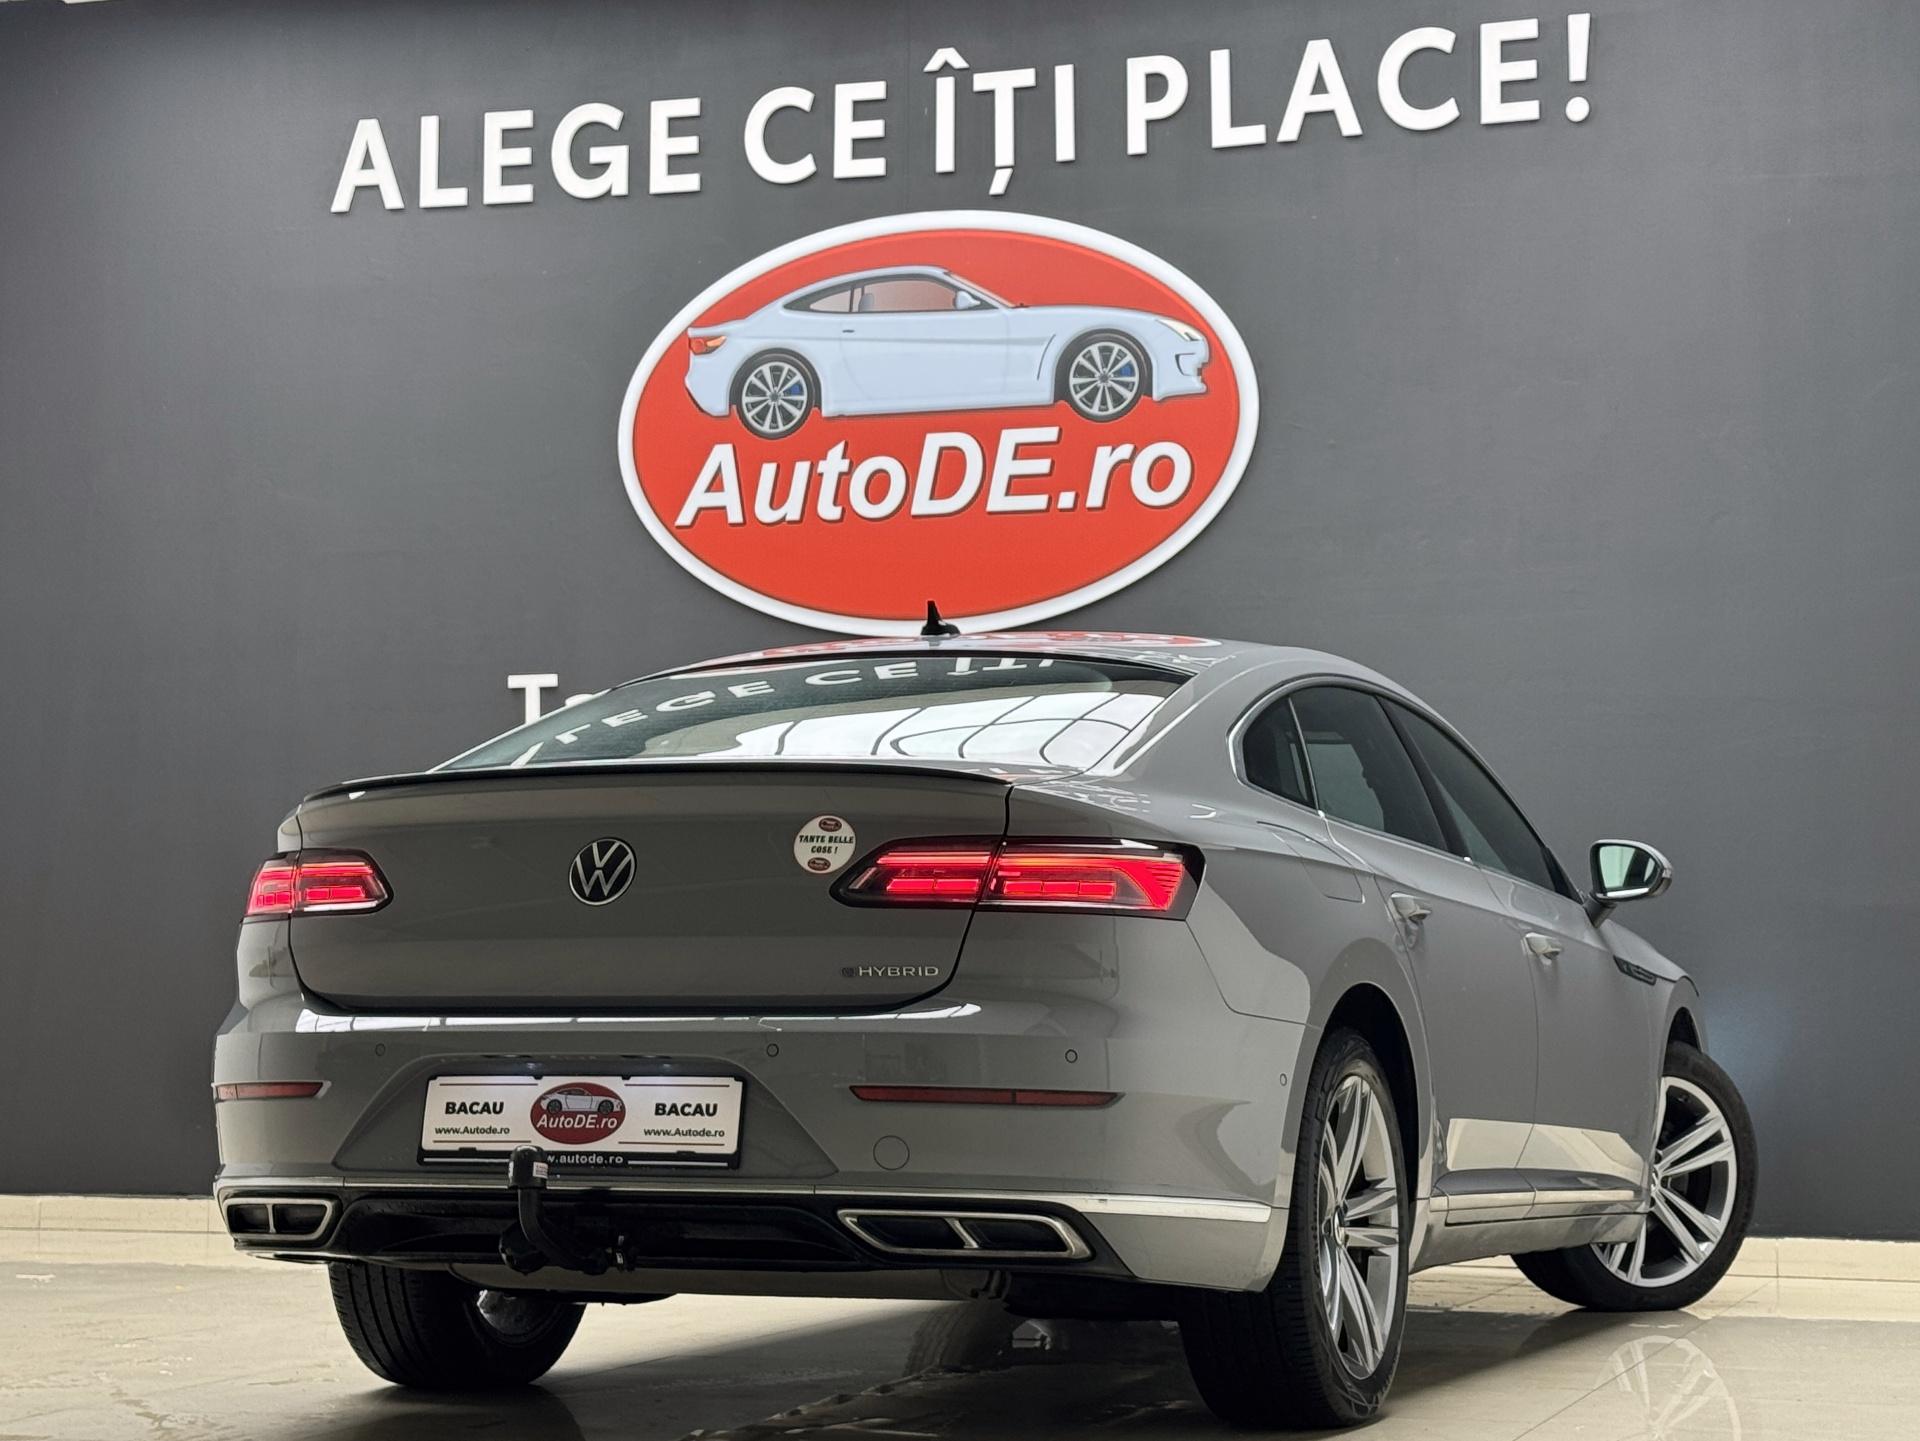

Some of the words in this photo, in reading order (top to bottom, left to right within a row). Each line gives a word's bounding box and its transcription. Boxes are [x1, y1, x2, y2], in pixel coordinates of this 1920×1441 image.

[330, 97, 702, 213] ALEGE
[744, 80, 887, 184] CE
[923, 47, 1075, 195] ÎȚI
[1126, 12, 1591, 155] PLACE!
[675, 426, 1193, 528] AutoDE.ro
[799, 835, 826, 843] TANTE
[445, 1101, 504, 1115] BACAU
[654, 1103, 718, 1117] BACAU
[537, 1114, 618, 1129] AutoDE.ro
[435, 1126, 510, 1135] www.Autode.ro
[644, 1128, 725, 1138] www.Autode.ro
